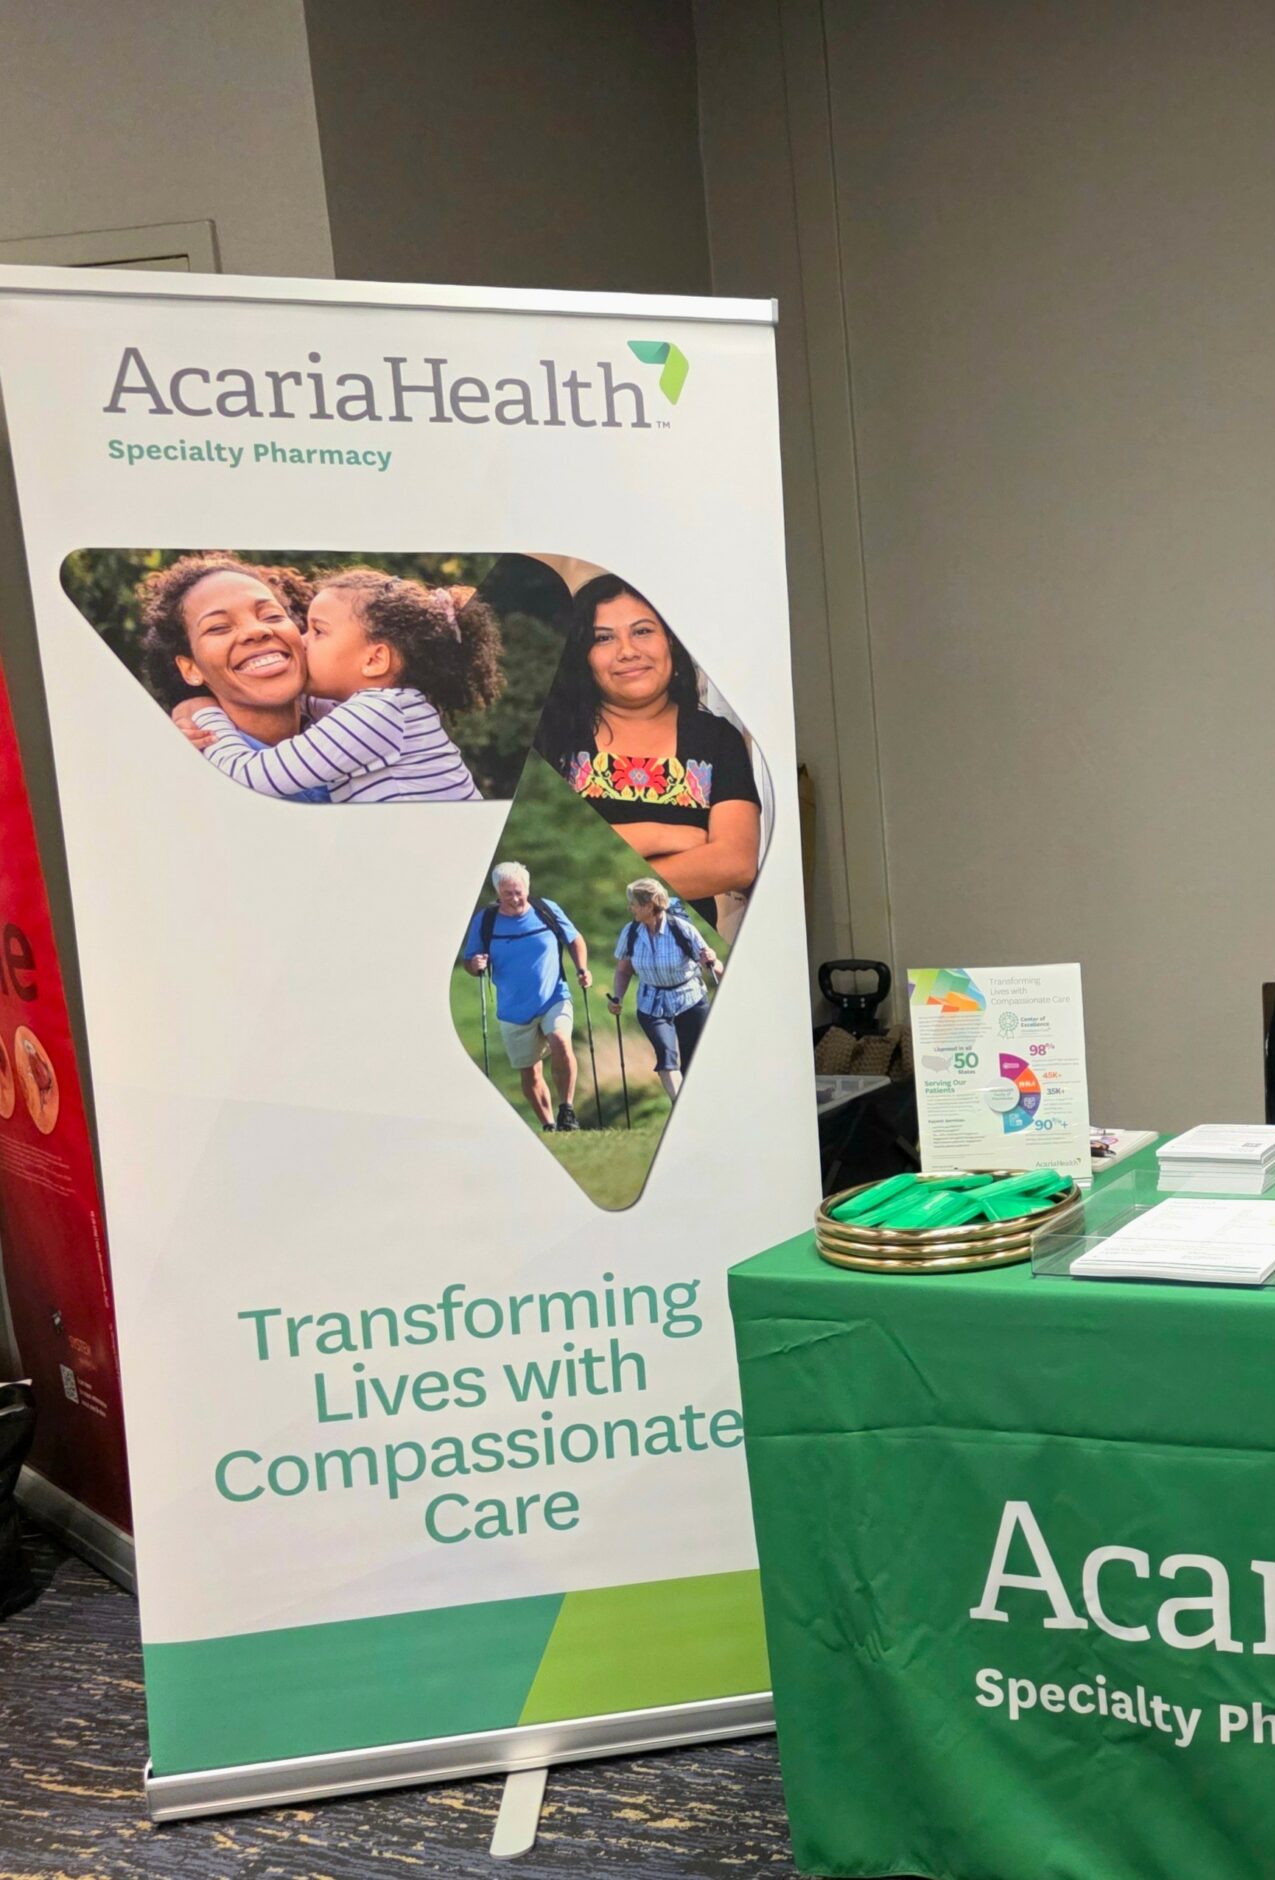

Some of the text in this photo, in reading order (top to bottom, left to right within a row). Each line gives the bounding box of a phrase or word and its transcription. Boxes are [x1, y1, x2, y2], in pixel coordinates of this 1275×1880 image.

[102, 346, 652, 429] AcariaHealth
[108, 438, 393, 473] Specialty Pharmacy
[990, 976, 1041, 987] Transforming
[990, 986, 1028, 996] Lives with
[991, 995, 1071, 1006] Compassionate Care
[953, 1051, 980, 1070] 50
[924, 1080, 952, 1089] Serving
[924, 1087, 956, 1096] Patients
[237, 1271, 704, 1362] Transforming
[313, 1337, 648, 1424] Lives with
[214, 1403, 745, 1503] Compassionate
[424, 1488, 580, 1545] Care
[975, 1667, 1201, 1749] Specialty
